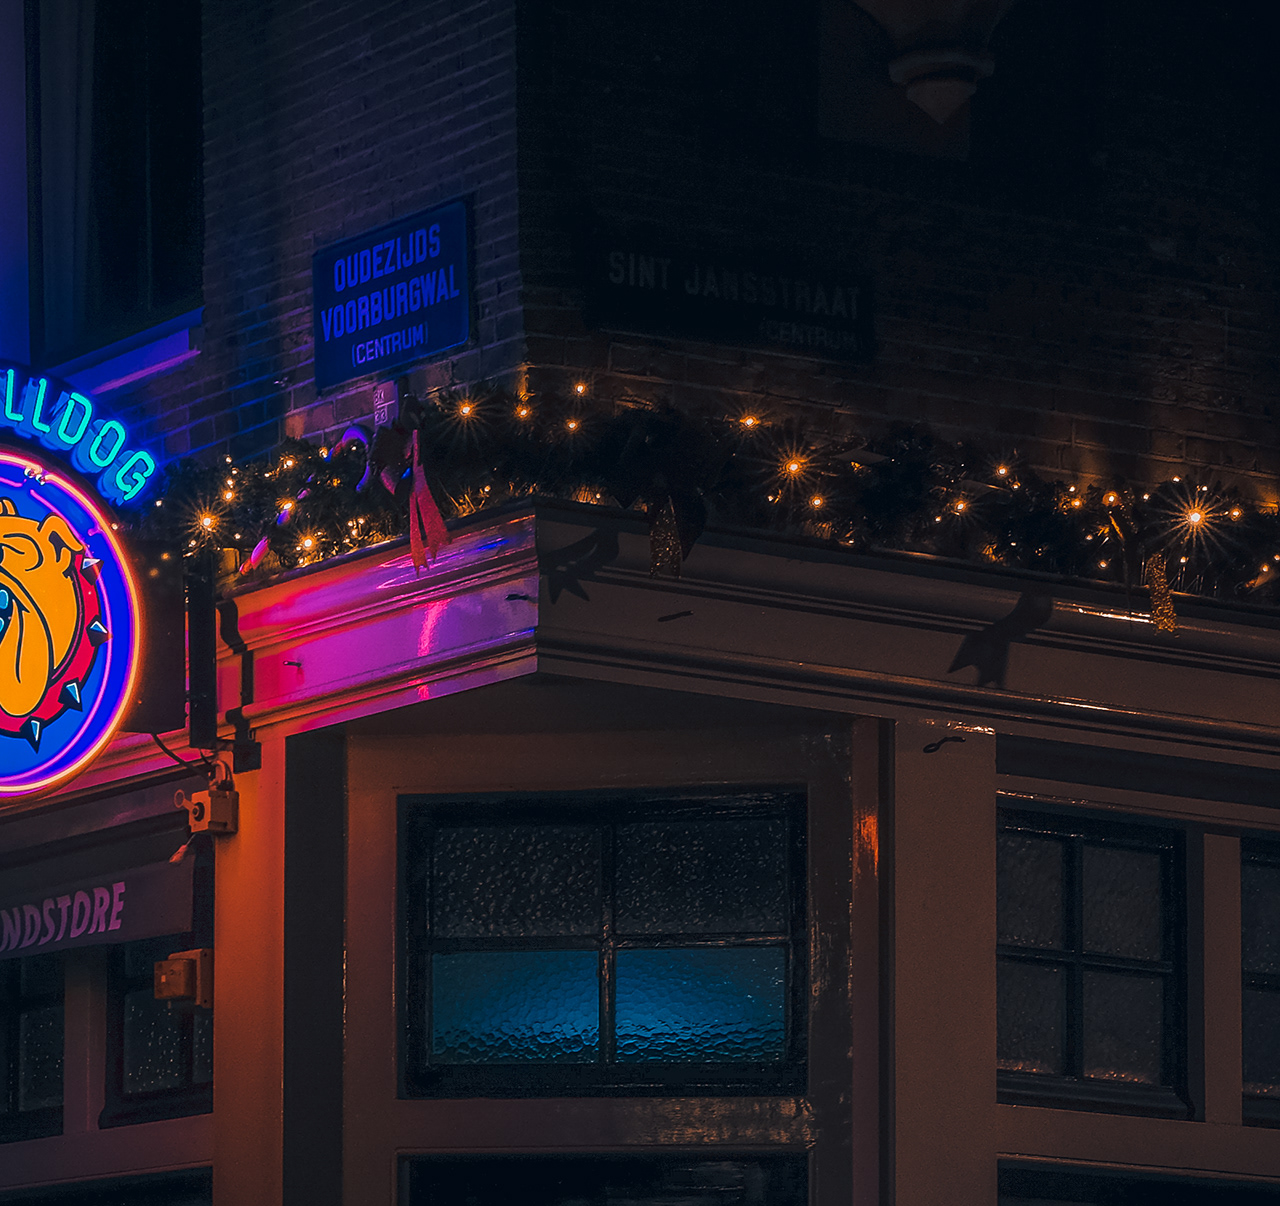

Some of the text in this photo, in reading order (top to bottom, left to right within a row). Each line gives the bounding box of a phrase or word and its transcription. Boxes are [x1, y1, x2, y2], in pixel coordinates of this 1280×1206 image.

[334, 224, 440, 292] OUDEZIJDS
[608, 251, 860, 320] SINT JANSSTRAAT
[321, 265, 460, 342] VOORBURGWAL
[351, 321, 428, 368] (CENTRUM)
